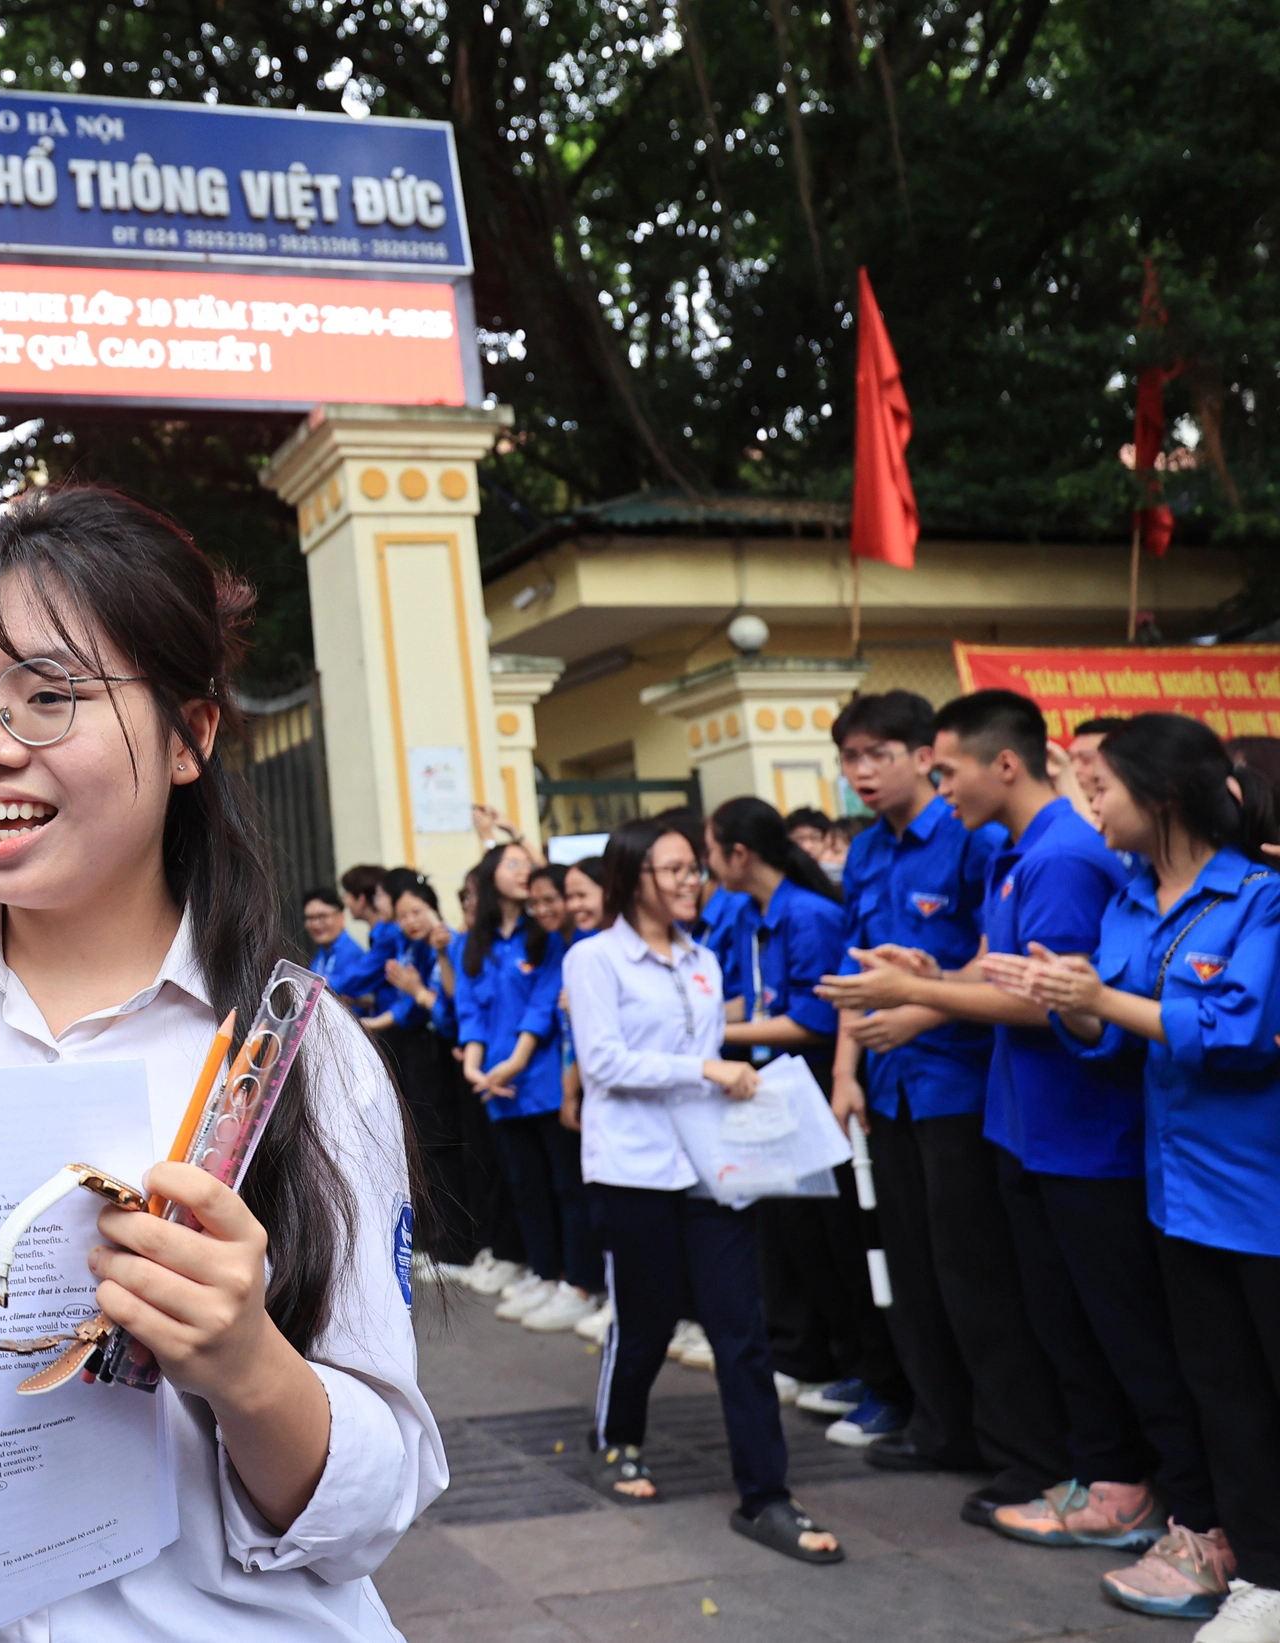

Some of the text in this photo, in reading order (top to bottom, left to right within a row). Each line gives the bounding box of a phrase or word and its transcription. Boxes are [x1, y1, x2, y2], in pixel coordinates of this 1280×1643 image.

[27, 106, 69, 137] HÀ
[75, 113, 125, 145] NỘI
[69, 154, 230, 218] THÔNG
[241, 162, 341, 230] VIỆT
[352, 166, 447, 229] ĐỨC
[70, 290, 133, 327] LỚP
[136, 296, 171, 327] 10
[174, 296, 248, 331] NĂM
[250, 300, 320, 337] HỌC
[100, 337, 165, 369] CAO
[169, 334, 256, 372] NHẤT
[260, 342, 271, 372] !
